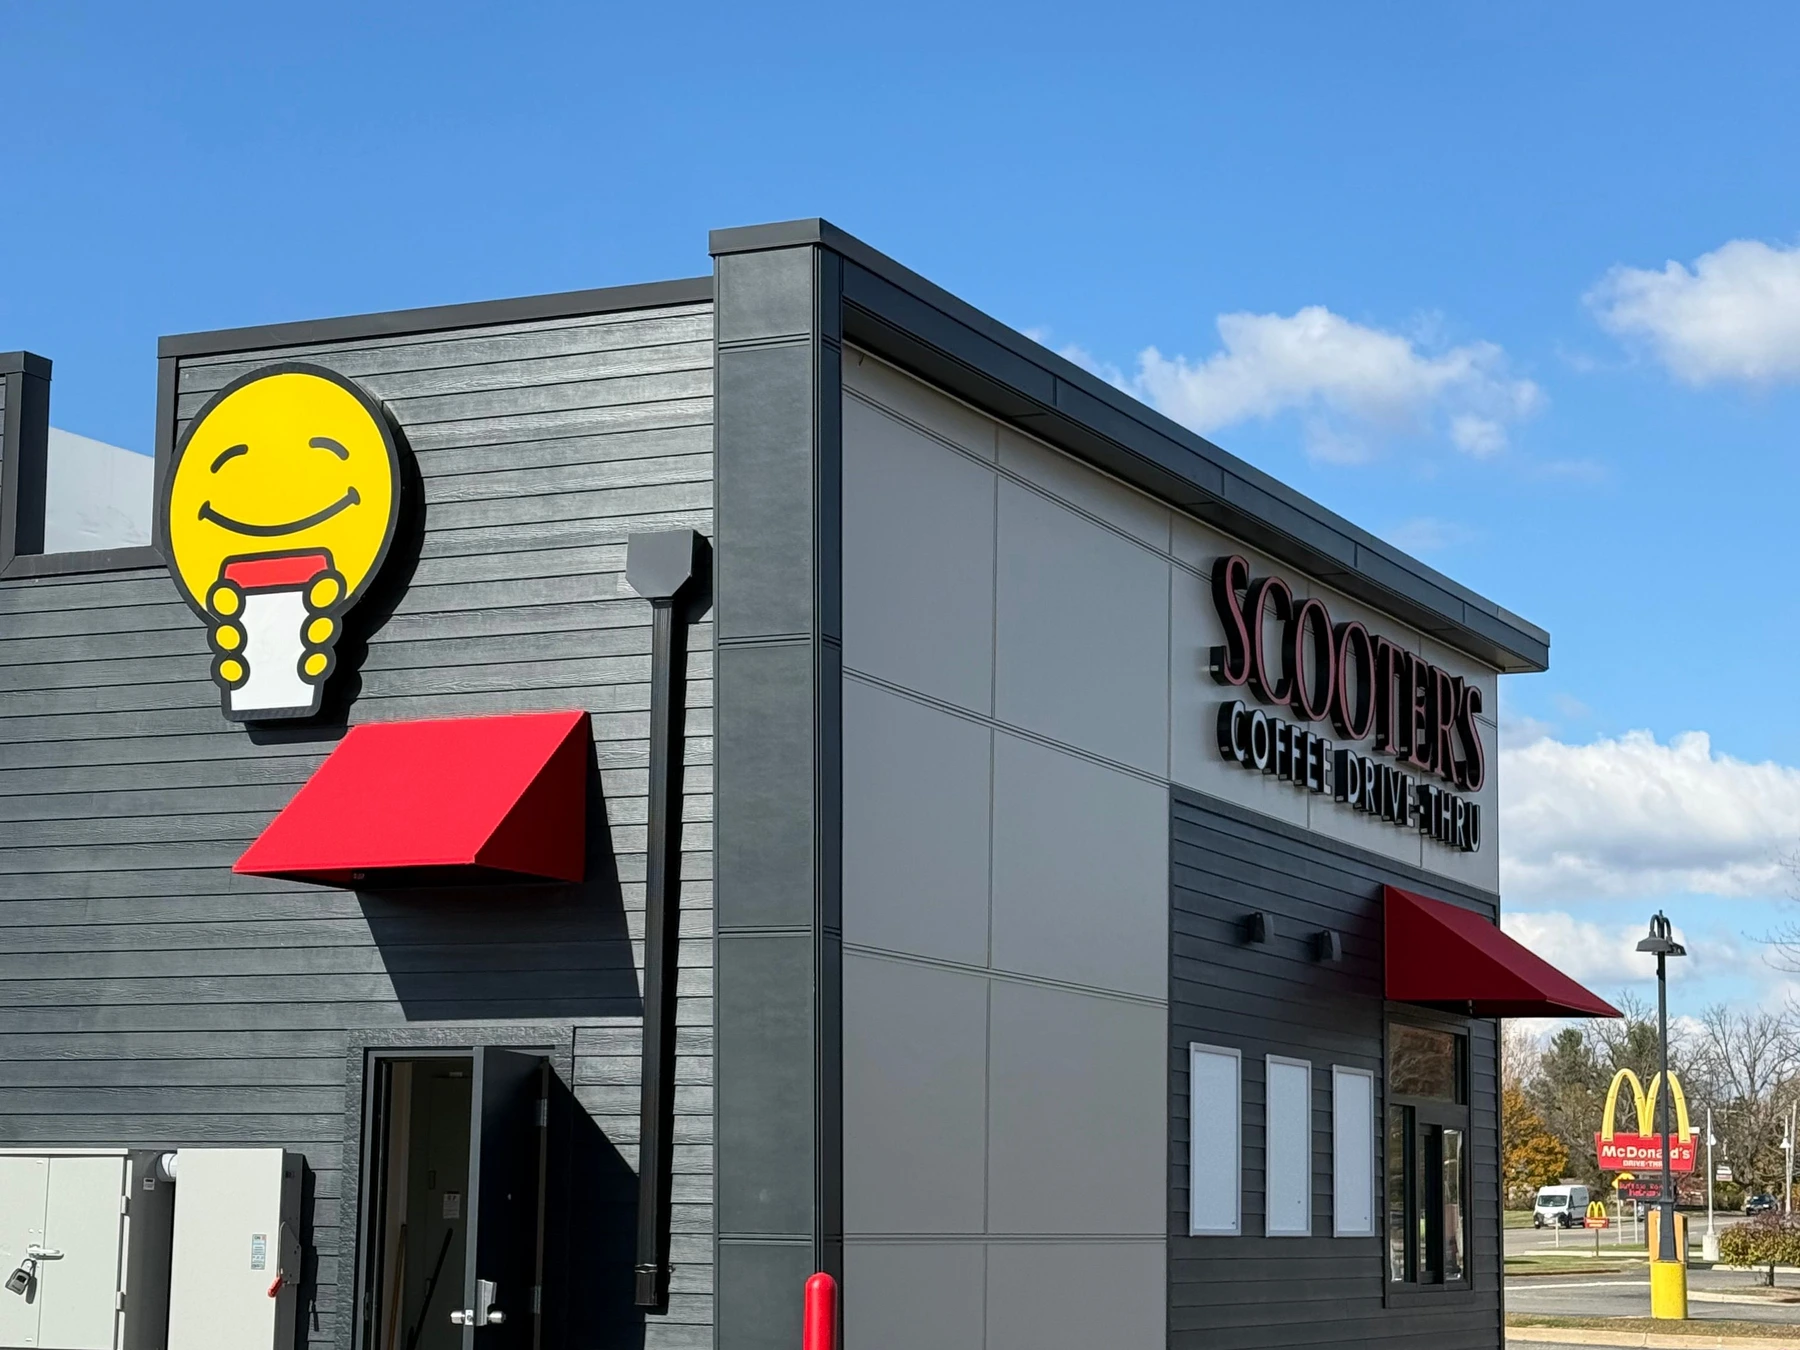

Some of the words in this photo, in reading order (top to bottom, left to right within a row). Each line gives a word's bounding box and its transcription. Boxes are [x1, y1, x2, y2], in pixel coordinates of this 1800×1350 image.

[1210, 555, 1485, 791] SCOOTER'S
[1217, 700, 1333, 795] COFFEE
[1335, 748, 1481, 853] DRIVE-THRU
[1602, 1146, 1691, 1159] McDonad's
